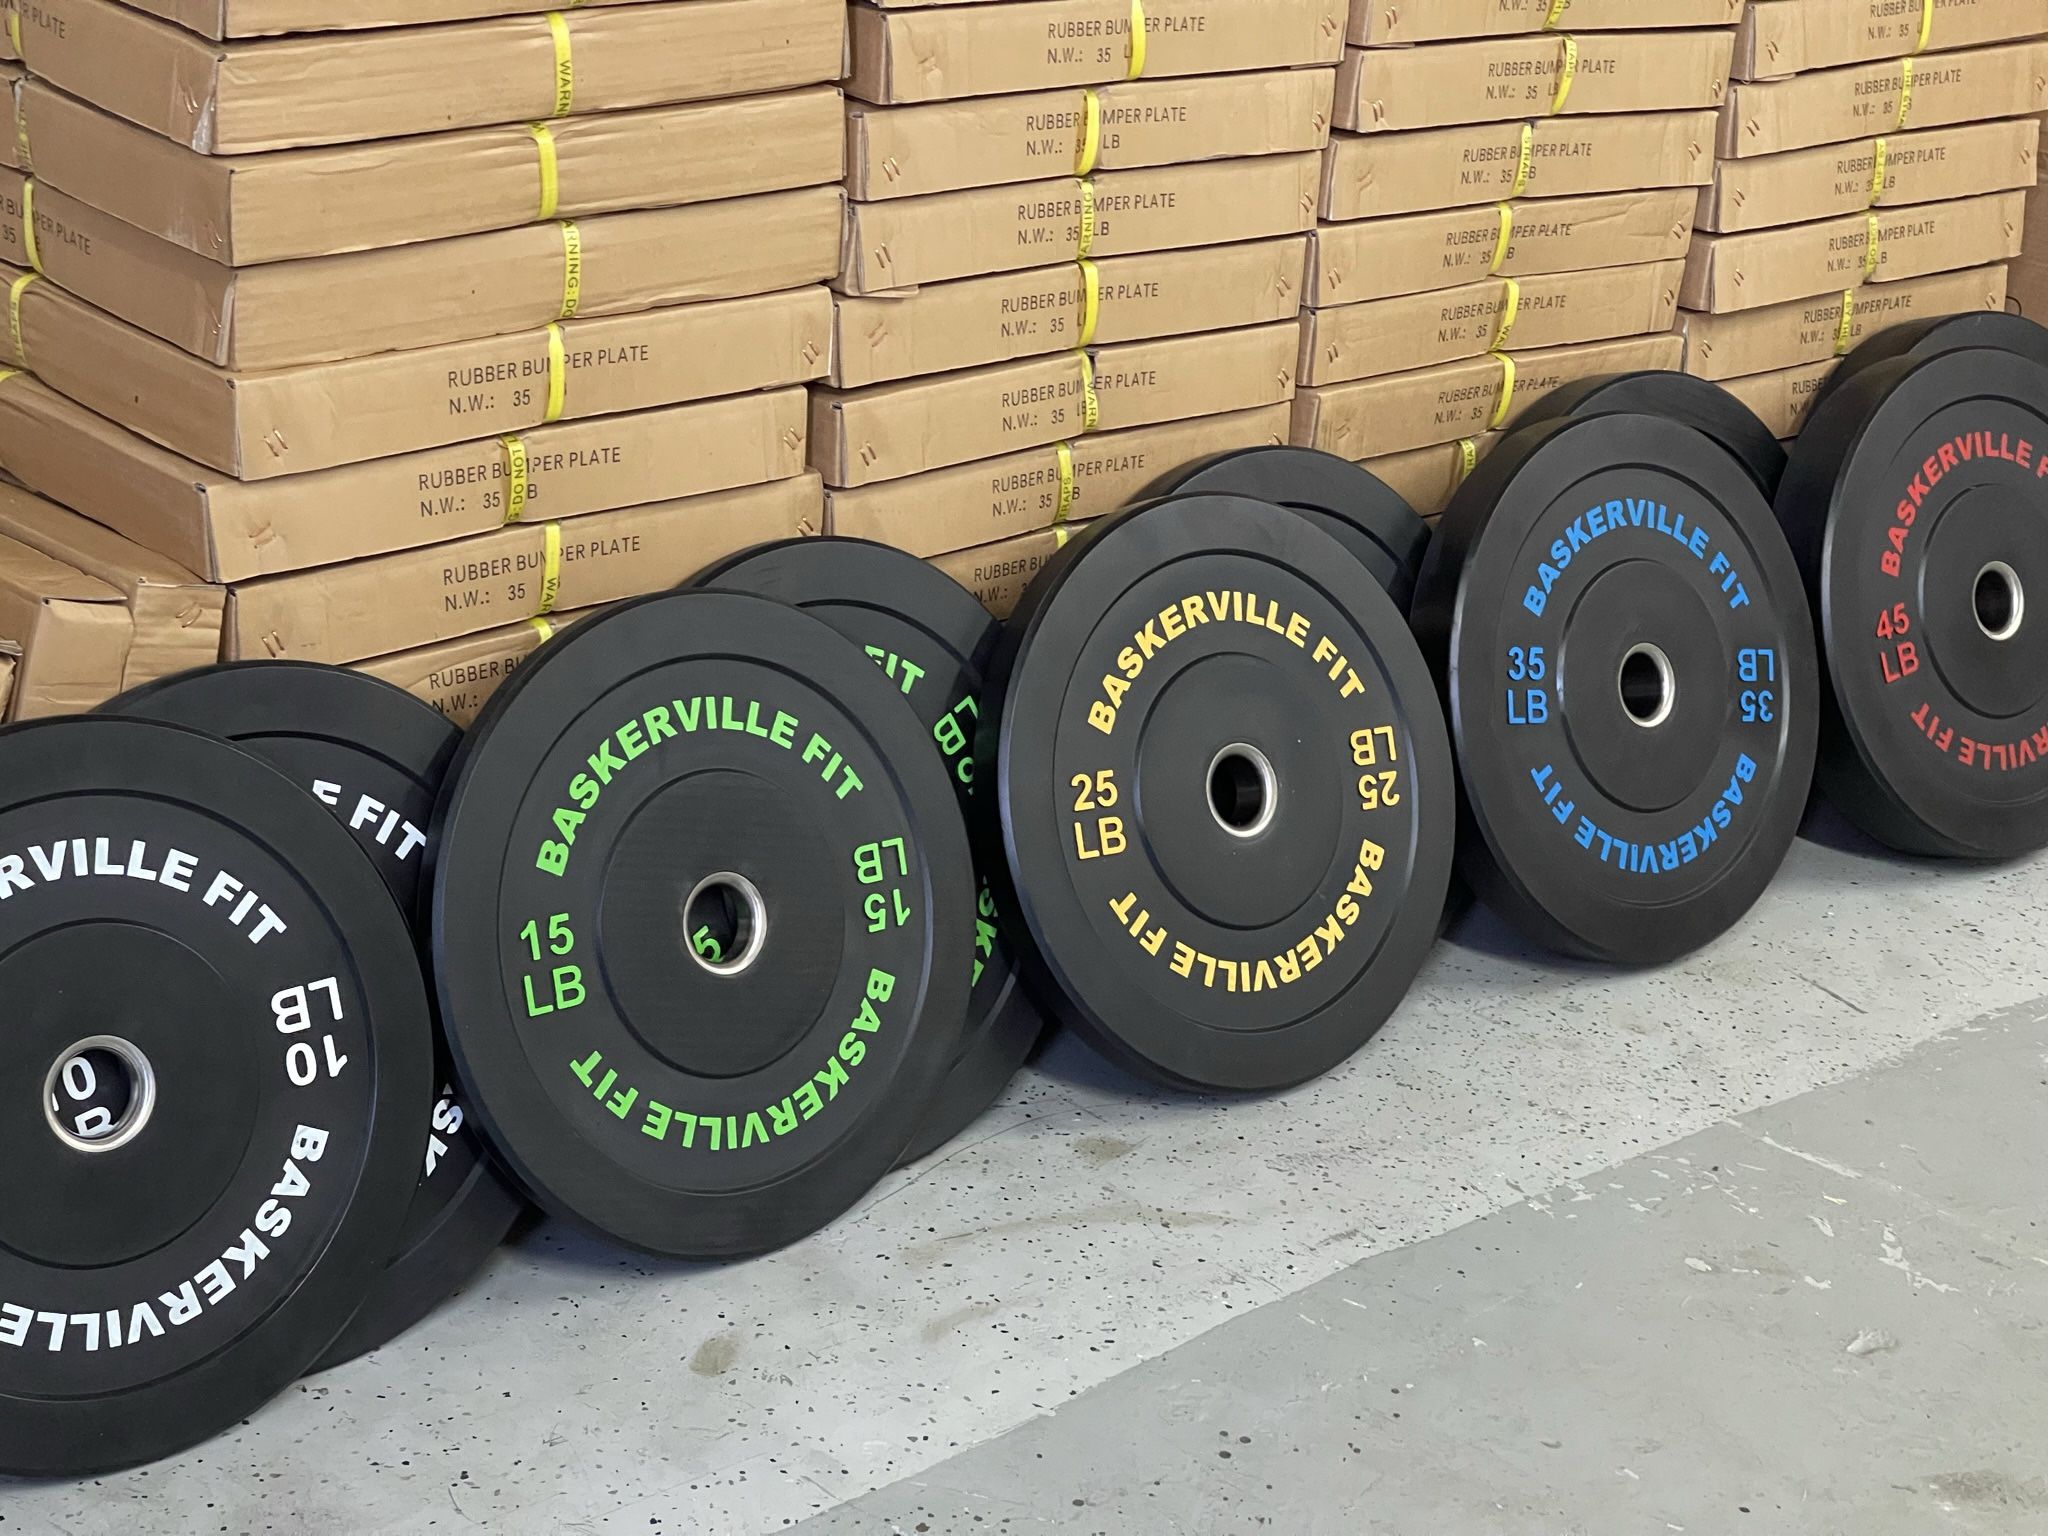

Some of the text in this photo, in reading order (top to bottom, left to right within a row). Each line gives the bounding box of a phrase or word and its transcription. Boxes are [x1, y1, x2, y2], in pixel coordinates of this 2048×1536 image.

[1870, 1, 1906, 18] RUBBER
[1048, 20, 1101, 38] RUBBER
[1164, 16, 1205, 32] PLATE
[1899, 24, 1909, 38] 35
[1047, 47, 1083, 64] N.W.:
[1096, 47, 1111, 63] 35
[1488, 61, 1532, 77] RUBBER
[1581, 59, 1616, 74] PLATE
[1525, 85, 1538, 100] 35
[1855, 79, 1891, 96] RUBBER
[1933, 69, 1962, 84] PLATE
[1026, 112, 1081, 131] RUBBER
[1145, 107, 1187, 123] PLATE
[1883, 101, 1893, 115] 35
[1026, 139, 1063, 156] N.W.:
[1103, 134, 1120, 149] LB
[1463, 142, 1592, 163] RUBBER PLATE
[1837, 147, 1946, 174] RUBBER PLATE
[1500, 169, 1512, 183] 35
[1883, 176, 1895, 189] LB
[1018, 200, 1070, 220] RUBBER
[1134, 193, 1175, 209] PLATE
[1018, 221, 1109, 245] N.W.: 35 LB
[1446, 223, 1573, 246] RUBBER PLATE
[1829, 221, 1935, 251] RUBBER PLATE
[1480, 250, 1491, 264] 35
[1001, 293, 1055, 314] RUBBER
[1117, 282, 1159, 299] PLATE
[1441, 295, 1567, 322] RUBBER PLATE
[1804, 295, 1912, 324] RUBBER PLATE
[1001, 319, 1037, 337] N.W.:
[1050, 317, 1065, 333] 35
[1476, 324, 1487, 339] 35
[1851, 324, 1862, 337] LB
[448, 362, 517, 388] RUBBER
[598, 345, 649, 365] PLATE
[449, 394, 495, 415] N.W.:
[513, 389, 531, 407] 35
[1002, 371, 1156, 407] RUBBER PLATE
[1438, 376, 1560, 404] RUBBER PLATE
[1792, 378, 1823, 395] RUBBE
[1003, 412, 1038, 432] N.W.:
[1051, 408, 1065, 424] 35
[1471, 406, 1483, 420] 35
[418, 465, 487, 490] RUBBER
[569, 447, 621, 467] PLATE
[511, 448, 525, 480] NOT
[992, 471, 1044, 494] RUBBER
[1106, 454, 1145, 473] PLATE
[421, 496, 465, 517] N.W.:
[483, 491, 500, 509] 35
[513, 483, 525, 505] DO
[992, 498, 1026, 517] N.W.:
[1039, 493, 1053, 509] 35
[1881, 431, 2033, 577] BASKERVILLE
[443, 558, 511, 585] RUBBER
[591, 536, 640, 557] PLATE
[974, 559, 1026, 582] RUBBER
[1522, 498, 1750, 617] BASKERVILLE FIT
[445, 590, 490, 611] N.W.:
[508, 583, 526, 600] 35
[1876, 602, 1910, 641] 45
[429, 661, 499, 689] RUBBER
[1088, 590, 1366, 735] BASKERVILLE FIT
[1507, 646, 1546, 681] 35
[1737, 648, 1774, 682] LB
[1880, 640, 1920, 684] LB
[1507, 689, 1549, 726] LB
[1740, 690, 1774, 723] 35
[1910, 702, 1954, 753] FIT
[1349, 725, 1397, 766] LB
[536, 696, 864, 877] BASKERVILLE FIT
[1070, 769, 1118, 811] 25
[1358, 770, 1400, 811] 25
[349, 794, 427, 860] FIT
[1530, 752, 1758, 874] BASKERVILLE FIT
[1074, 816, 1127, 860] LB
[853, 837, 908, 885] LB
[203, 870, 287, 944] FIT
[864, 888, 911, 932] 15
[1169, 838, 1385, 993] BASKERVILLE
[520, 913, 575, 961] 15
[1109, 892, 1168, 957] FIT
[271, 976, 344, 1033] LB
[523, 965, 586, 1017] LB
[286, 1035, 348, 1086] 10
[569, 968, 896, 1151] BASKERVILLE FIT
[0, 1124, 329, 1351] BASKERVILLE
